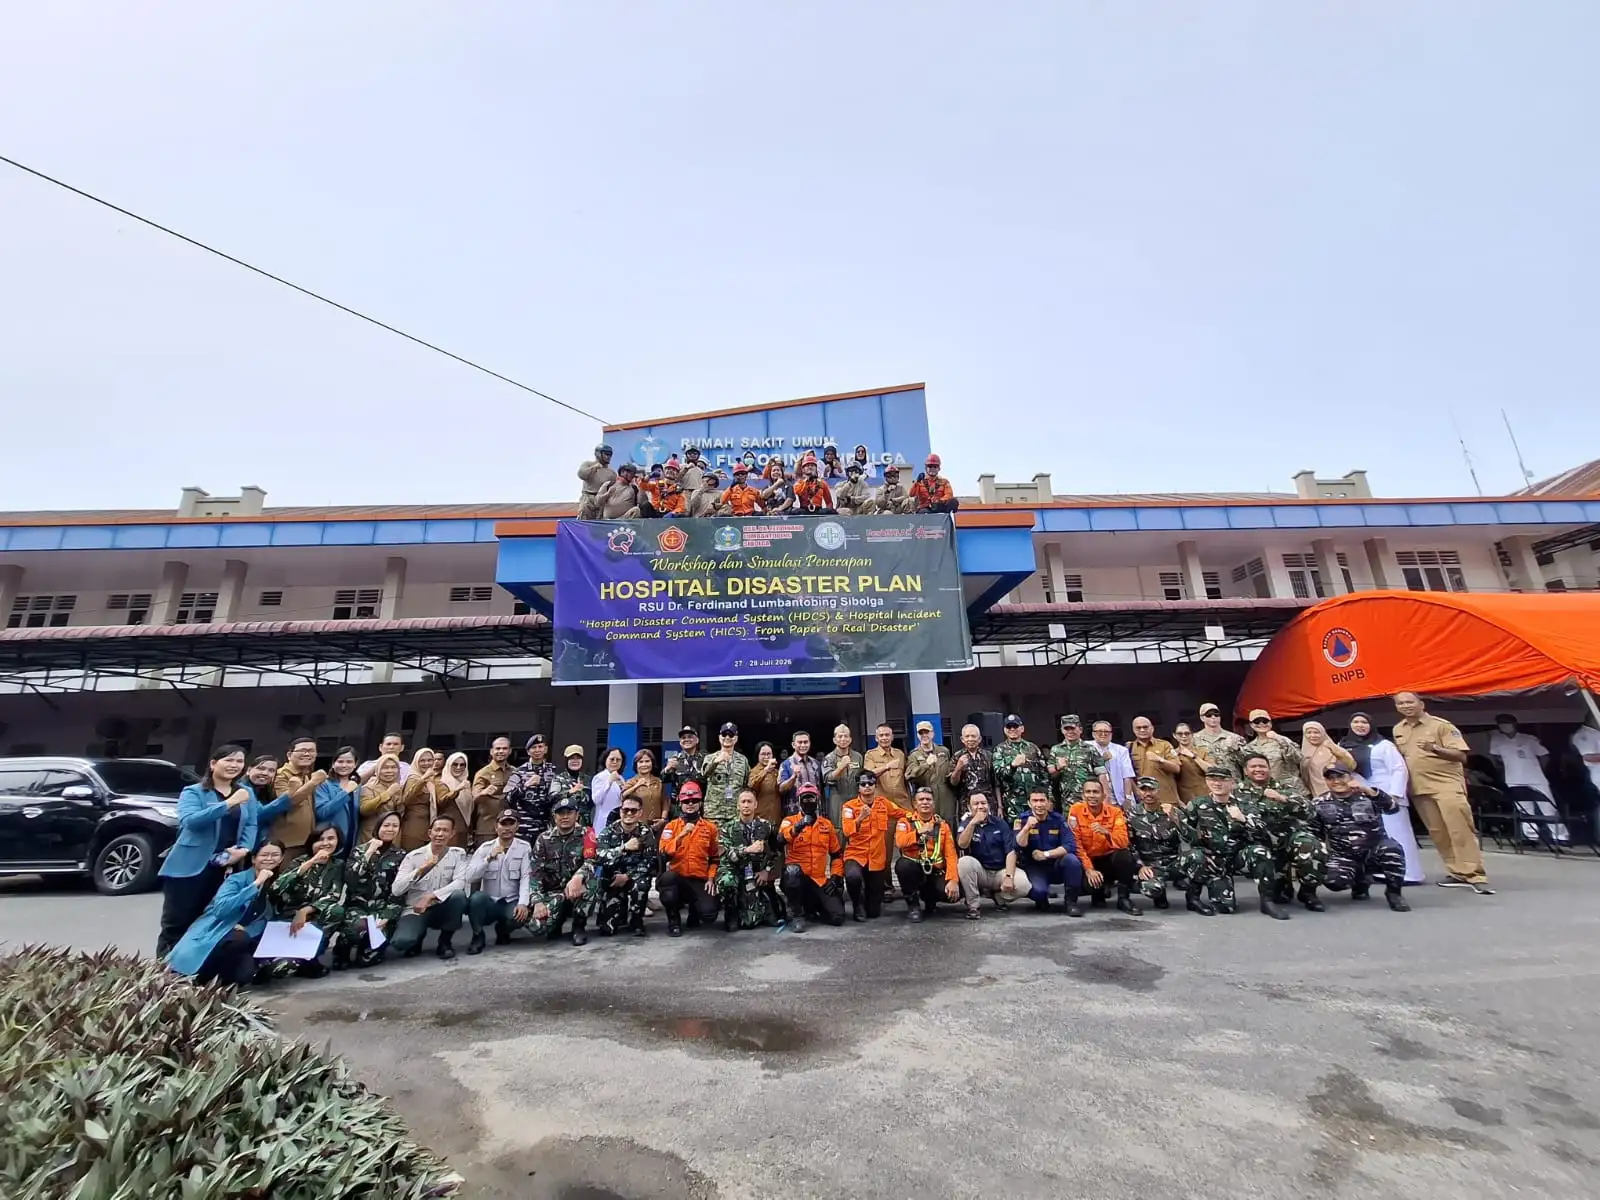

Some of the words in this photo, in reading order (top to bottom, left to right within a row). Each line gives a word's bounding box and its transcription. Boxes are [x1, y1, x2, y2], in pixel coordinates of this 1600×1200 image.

[681, 437, 734, 449] RUMAH
[740, 437, 785, 449] SAKIT
[792, 436, 836, 448] UMUM
[650, 555, 716, 576] Workshop
[718, 553, 743, 570] dan
[747, 552, 802, 570] Simulasi
[806, 554, 872, 573] Penerapan
[600, 578, 720, 600] HOSPITAL
[727, 575, 851, 596] DISASTER
[858, 574, 922, 593] PLAN
[639, 602, 664, 612] RSU
[668, 601, 684, 611] Dr.
[688, 599, 748, 610] Ferdinand
[751, 597, 837, 609] Lumbantobing
[840, 596, 884, 608] Sibolga
[633, 617, 677, 627] Disaster
[681, 614, 738, 625] Command
[743, 613, 784, 626] System
[835, 611, 844, 621] &
[849, 610, 893, 623] Hospital
[897, 609, 942, 619] Incident
[606, 630, 661, 641] Command
[665, 629, 706, 641] System
[754, 626, 785, 636] From
[789, 624, 822, 636] Paper
[827, 623, 838, 633] to
[842, 622, 866, 633] Real
[1331, 668, 1365, 684] BNPB
